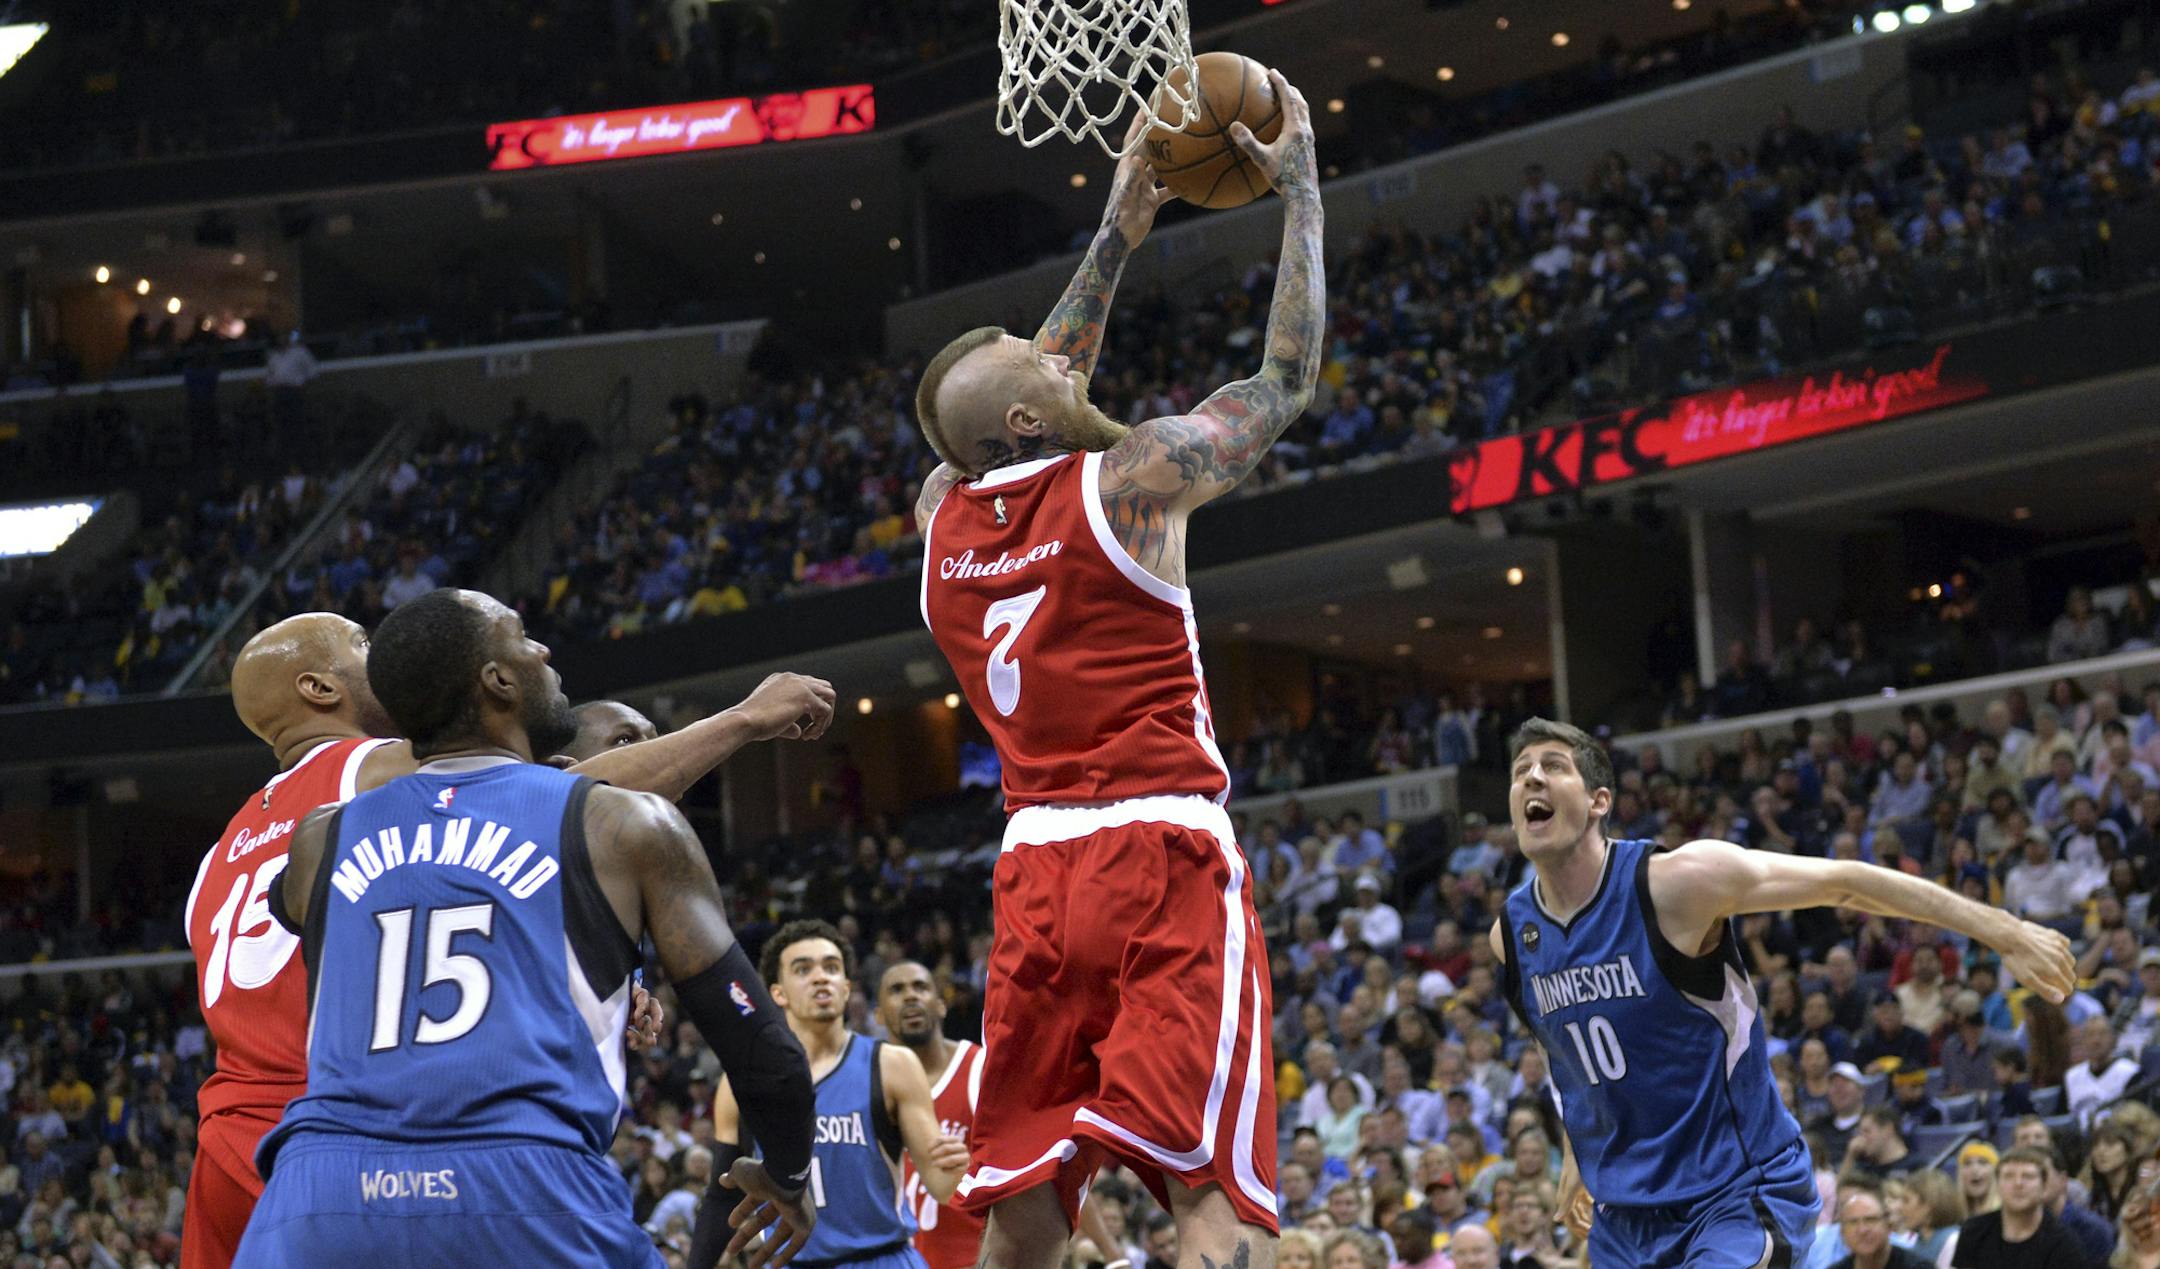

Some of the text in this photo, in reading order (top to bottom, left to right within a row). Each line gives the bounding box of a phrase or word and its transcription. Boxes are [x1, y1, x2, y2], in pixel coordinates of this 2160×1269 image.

[1516, 404, 1670, 496] KFC
[940, 540, 1064, 580] Andersen
[227, 817, 295, 863] Carter
[330, 817, 560, 904] MUHAMMAD
[203, 853, 300, 1008] 15
[367, 903, 495, 1056] 15
[1530, 954, 1648, 1018] MINNESOTA
[1564, 1015, 1627, 1085] 10
[813, 1111, 868, 1146] SOTA
[360, 1168, 459, 1205] WOLVES
